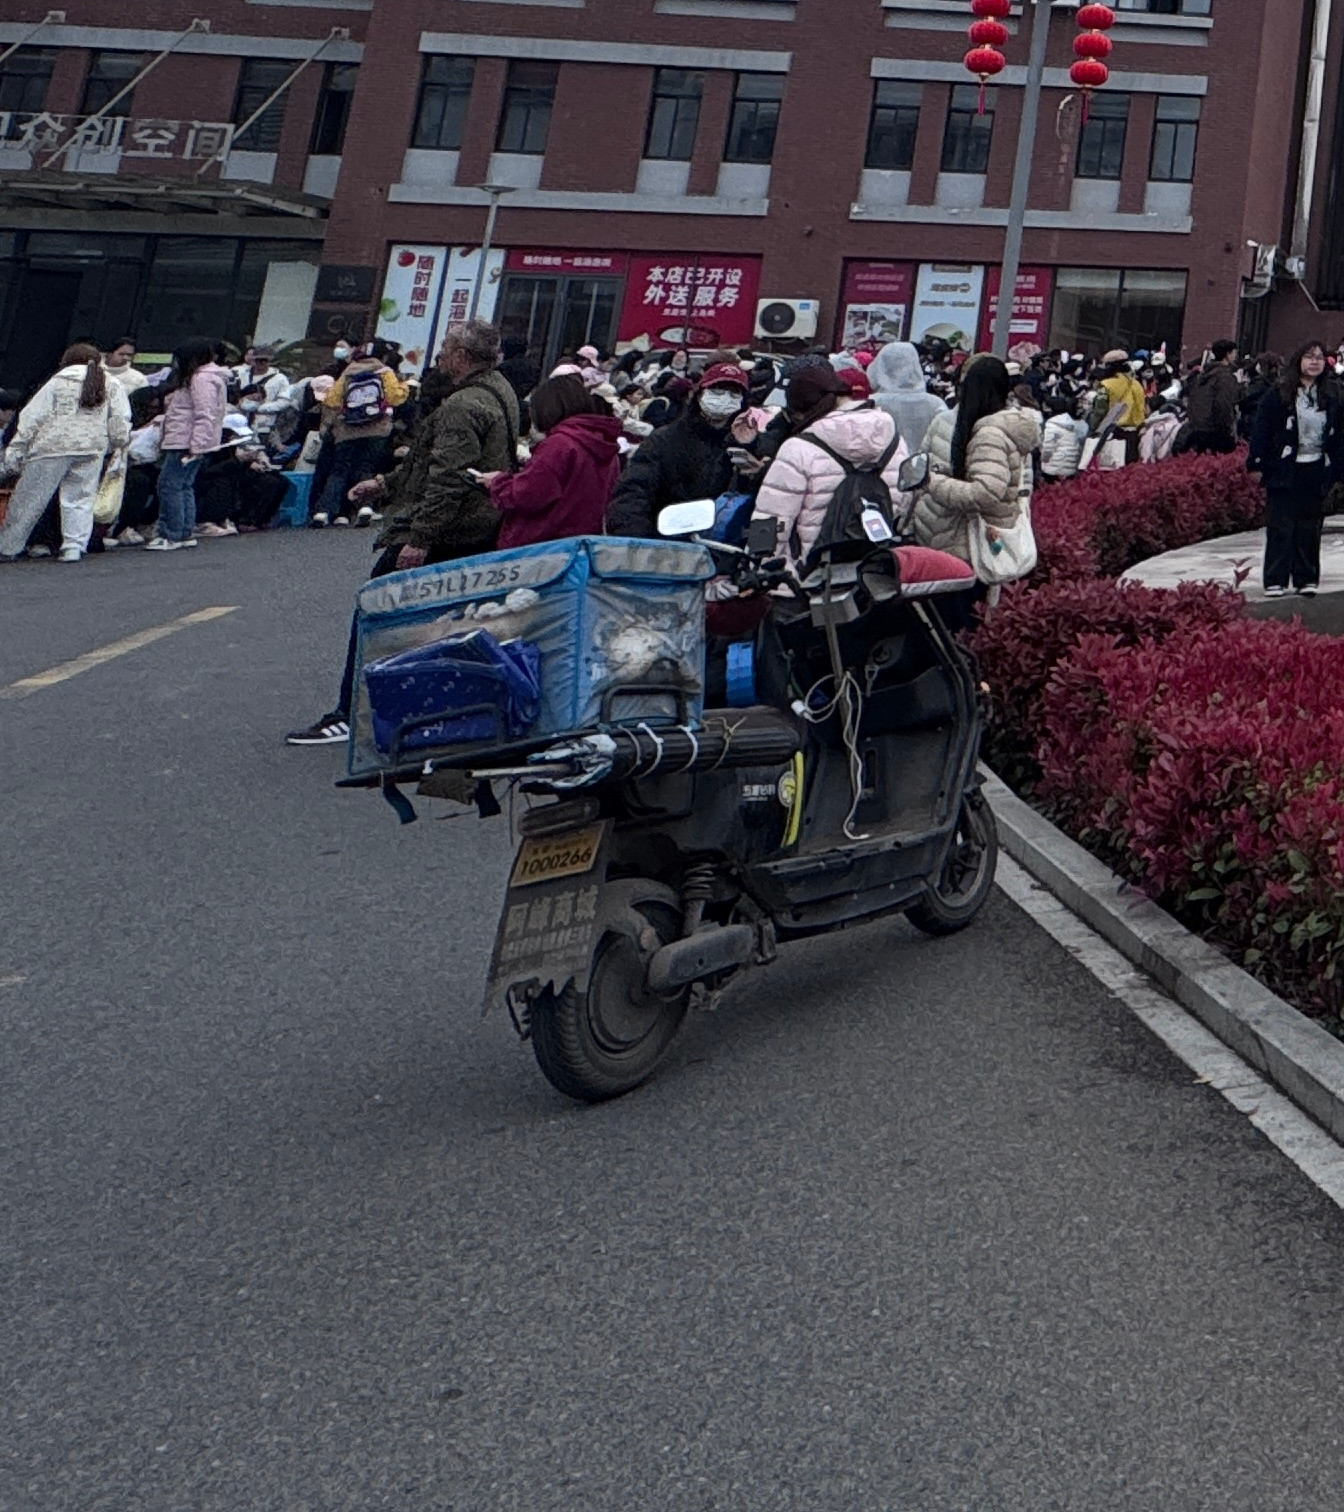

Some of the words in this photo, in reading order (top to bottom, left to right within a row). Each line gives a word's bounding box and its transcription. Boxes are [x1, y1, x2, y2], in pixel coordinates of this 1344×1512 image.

[0, 111, 235, 160] 众创空间
[646, 265, 744, 286] 本店已开设
[643, 285, 740, 308] 外送服务
